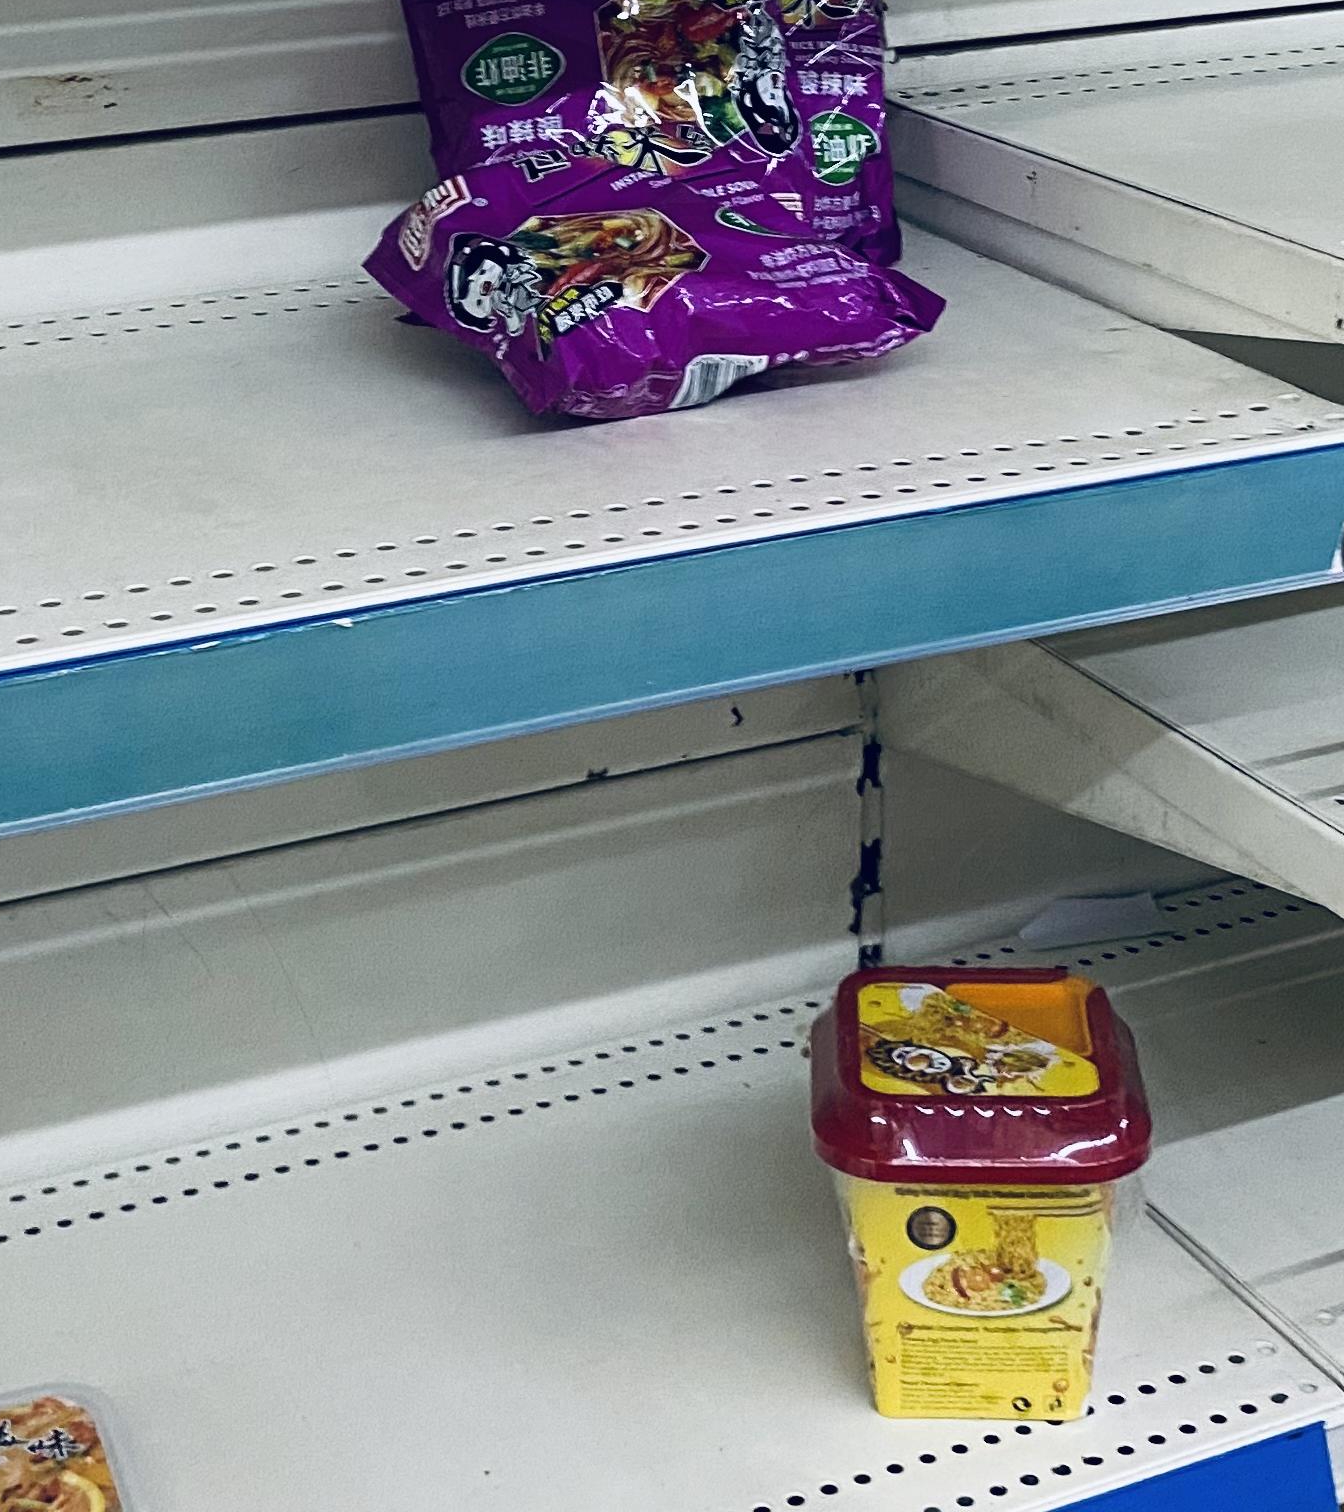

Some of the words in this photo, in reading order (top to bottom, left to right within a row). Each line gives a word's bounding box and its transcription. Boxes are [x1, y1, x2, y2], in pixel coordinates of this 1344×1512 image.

[475, 50, 554, 87] 非油炸
[796, 70, 869, 96] 酸辣味
[481, 114, 563, 149] 酸辣味
